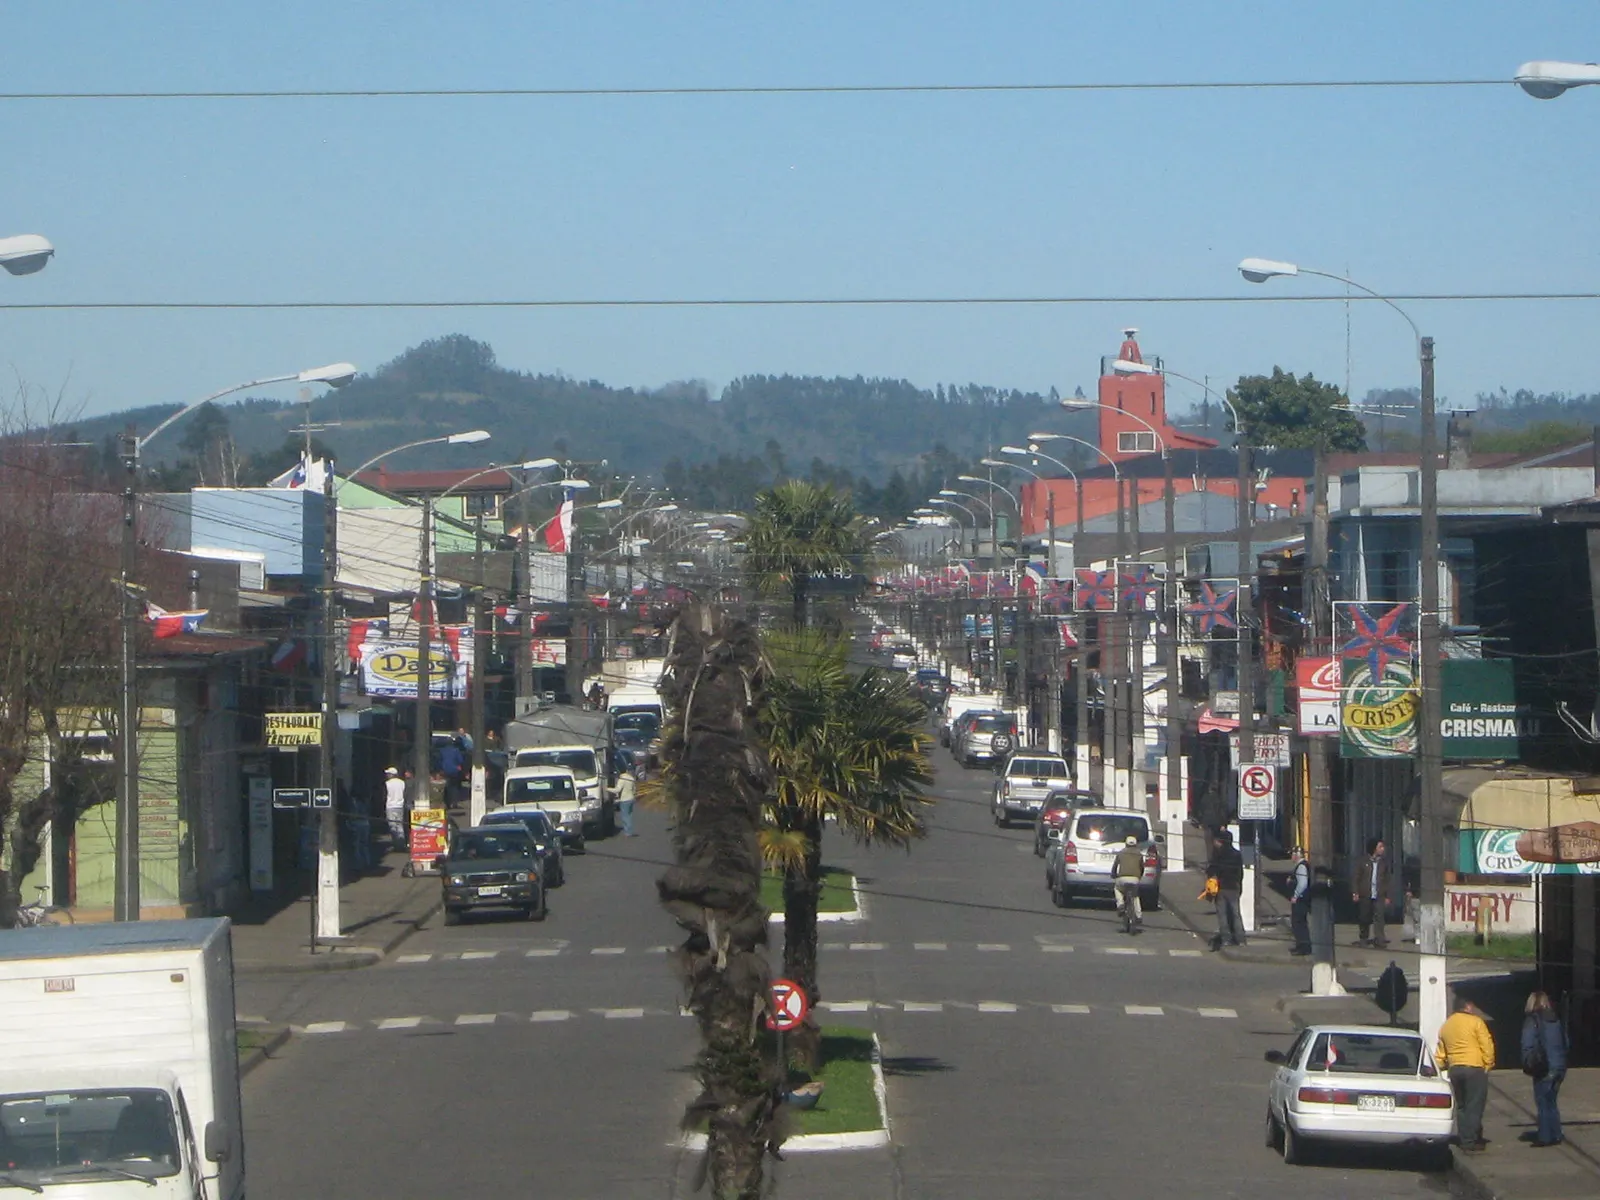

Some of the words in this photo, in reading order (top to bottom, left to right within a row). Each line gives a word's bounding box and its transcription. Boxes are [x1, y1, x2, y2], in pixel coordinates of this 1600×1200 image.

[1350, 698, 1415, 727] CRISTA
[1450, 703, 1472, 713] Café
[1480, 703, 1532, 713] Restaur
[1314, 714, 1337, 726] LA
[1234, 735, 1285, 747] MEBLES
[1485, 854, 1523, 870] CRIS
